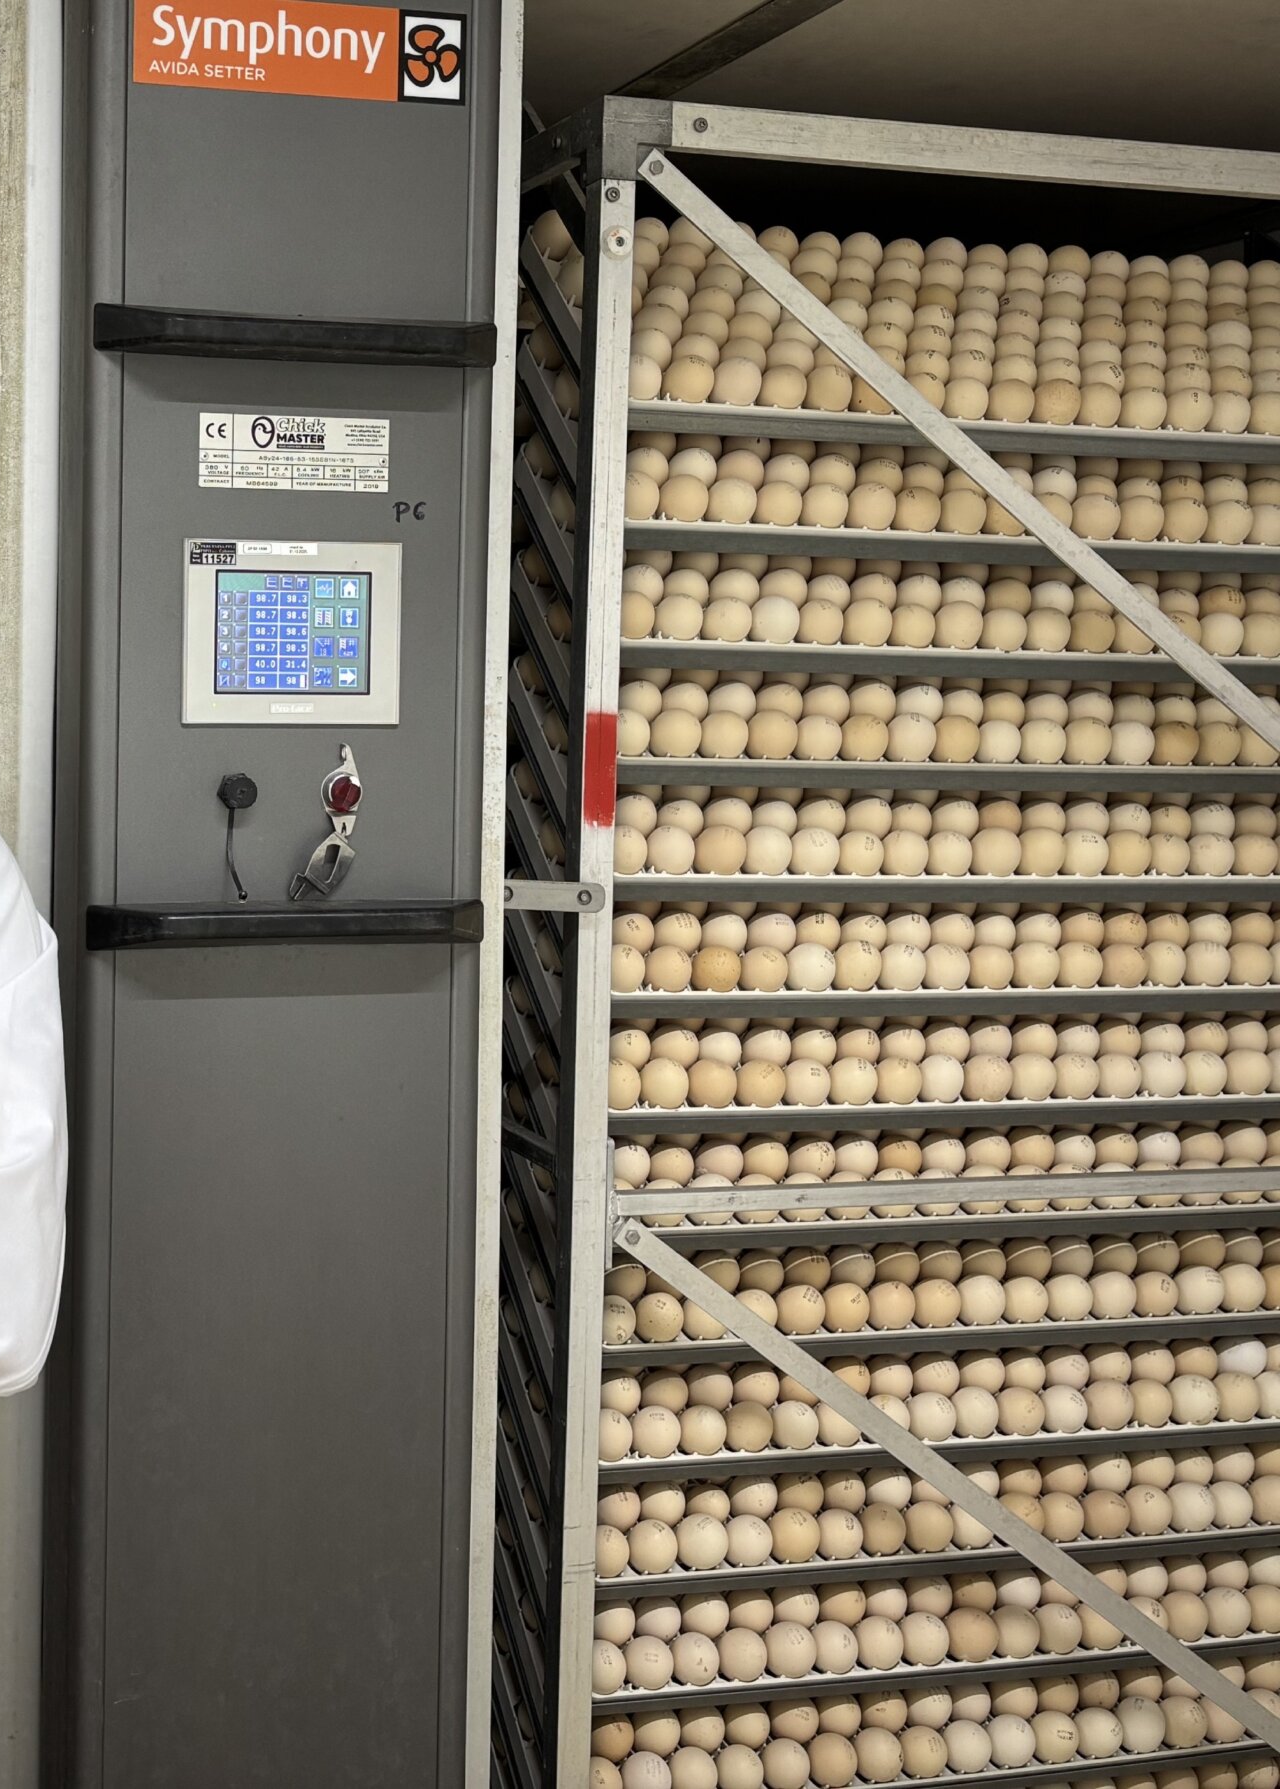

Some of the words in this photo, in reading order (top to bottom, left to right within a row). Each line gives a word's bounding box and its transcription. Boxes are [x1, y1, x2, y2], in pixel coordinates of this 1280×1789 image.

[152, 4, 386, 74] Symphony
[149, 60, 199, 76] AVIDA
[204, 64, 266, 81] SETTER
[276, 418, 326, 433] Chick
[205, 422, 227, 439] CE
[276, 433, 325, 444] MASTER
[204, 554, 234, 564] 11527
[255, 594, 276, 602] 98.7
[286, 594, 307, 603] 98.3
[222, 611, 228, 619] 2
[255, 611, 276, 619] 98.7
[286, 611, 307, 619] 98.6
[255, 627, 276, 635] 98.7
[286, 627, 307, 635] 98.6
[255, 644, 275, 652] 98.7
[286, 644, 306, 652] 98.5
[255, 660, 275, 668] 40.0
[286, 660, 306, 668] 31.4
[255, 676, 265, 684] 98
[286, 676, 296, 684] 98
